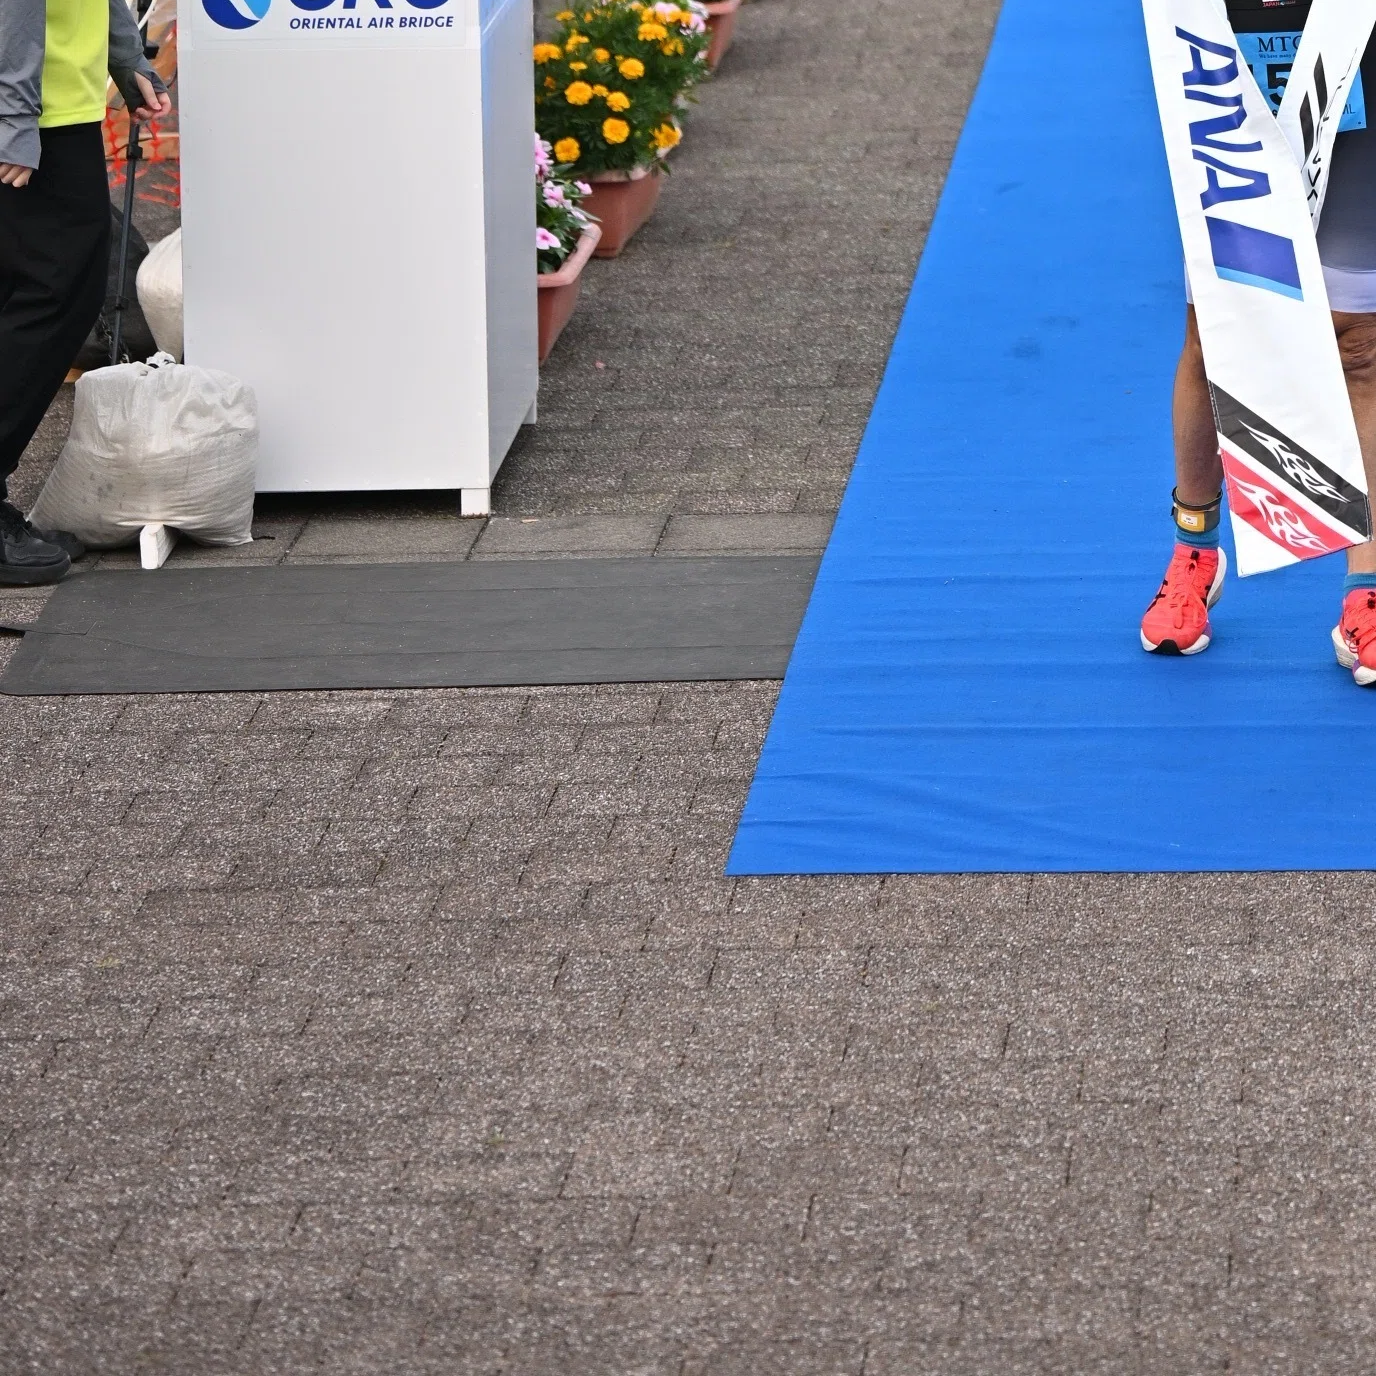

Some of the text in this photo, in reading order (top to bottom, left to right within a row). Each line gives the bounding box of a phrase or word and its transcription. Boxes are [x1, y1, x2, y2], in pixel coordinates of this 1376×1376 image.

[289, 15, 454, 30] ORIENTAL AIR BRIDGE
[1174, 25, 1272, 211] ANA
